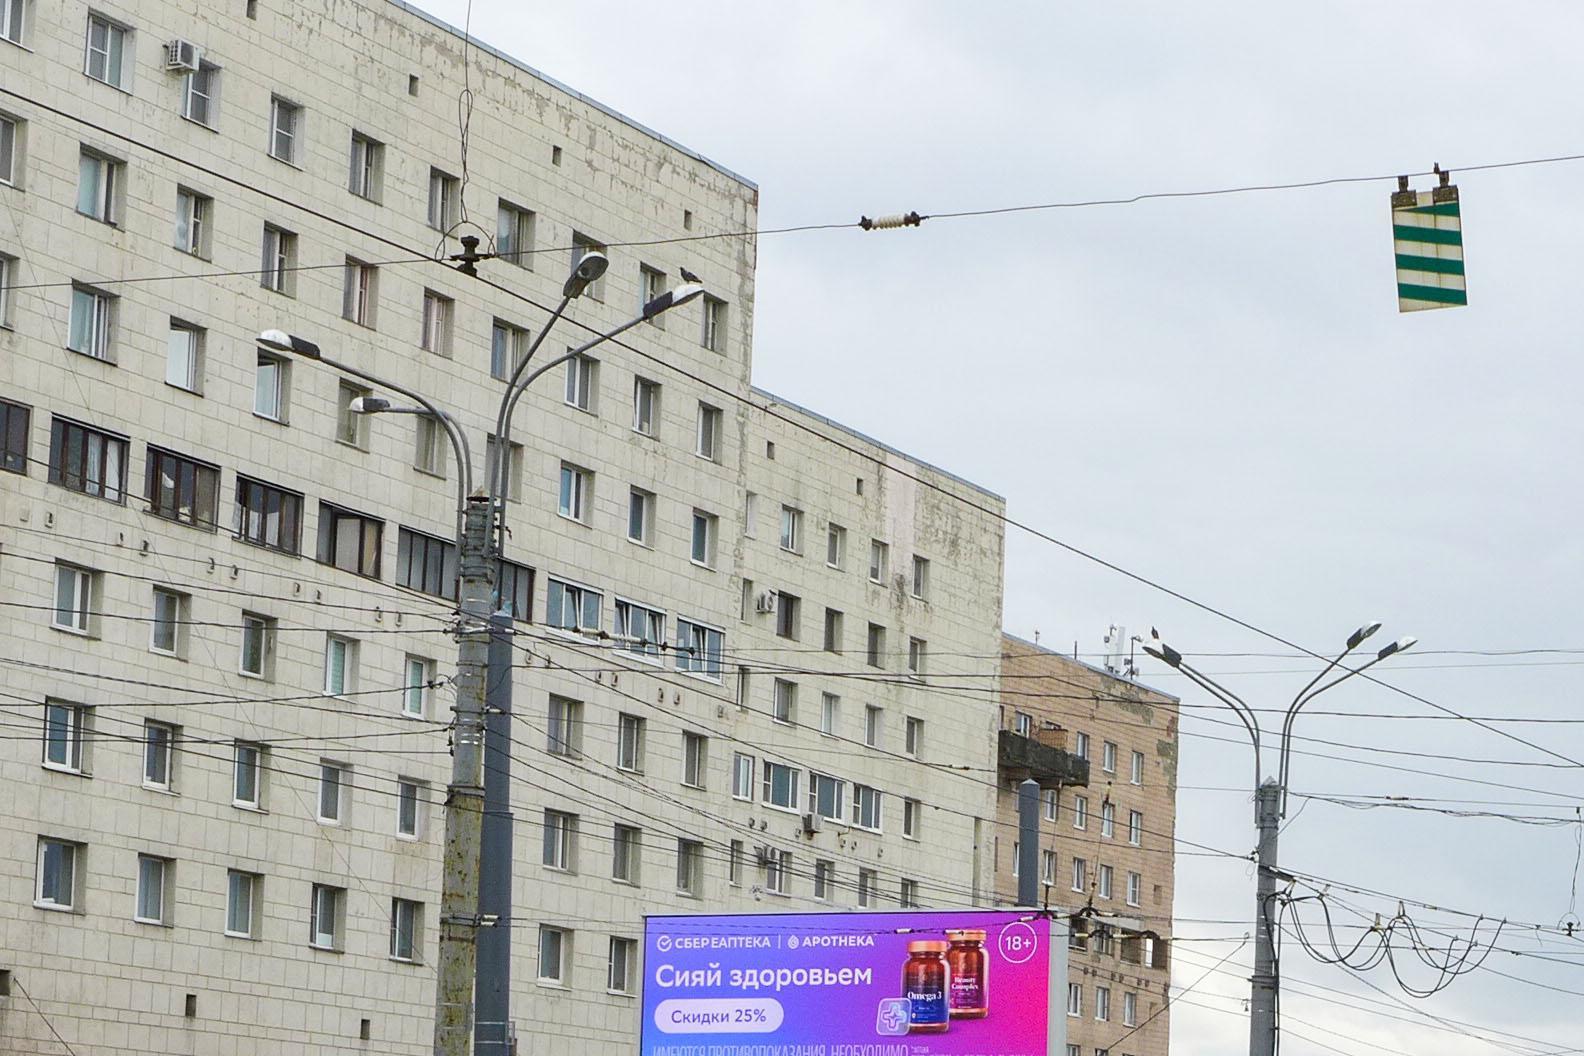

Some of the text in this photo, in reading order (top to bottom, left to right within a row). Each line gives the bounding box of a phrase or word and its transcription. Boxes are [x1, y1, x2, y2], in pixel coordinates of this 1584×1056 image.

[675, 936, 771, 949] СБЕРЕАПТЕКА
[1005, 936, 1032, 951] 18+
[655, 962, 873, 992] Сияй здоровьем
[907, 991, 936, 1002] Omega
[671, 1009, 767, 1025] Скидки 25%
